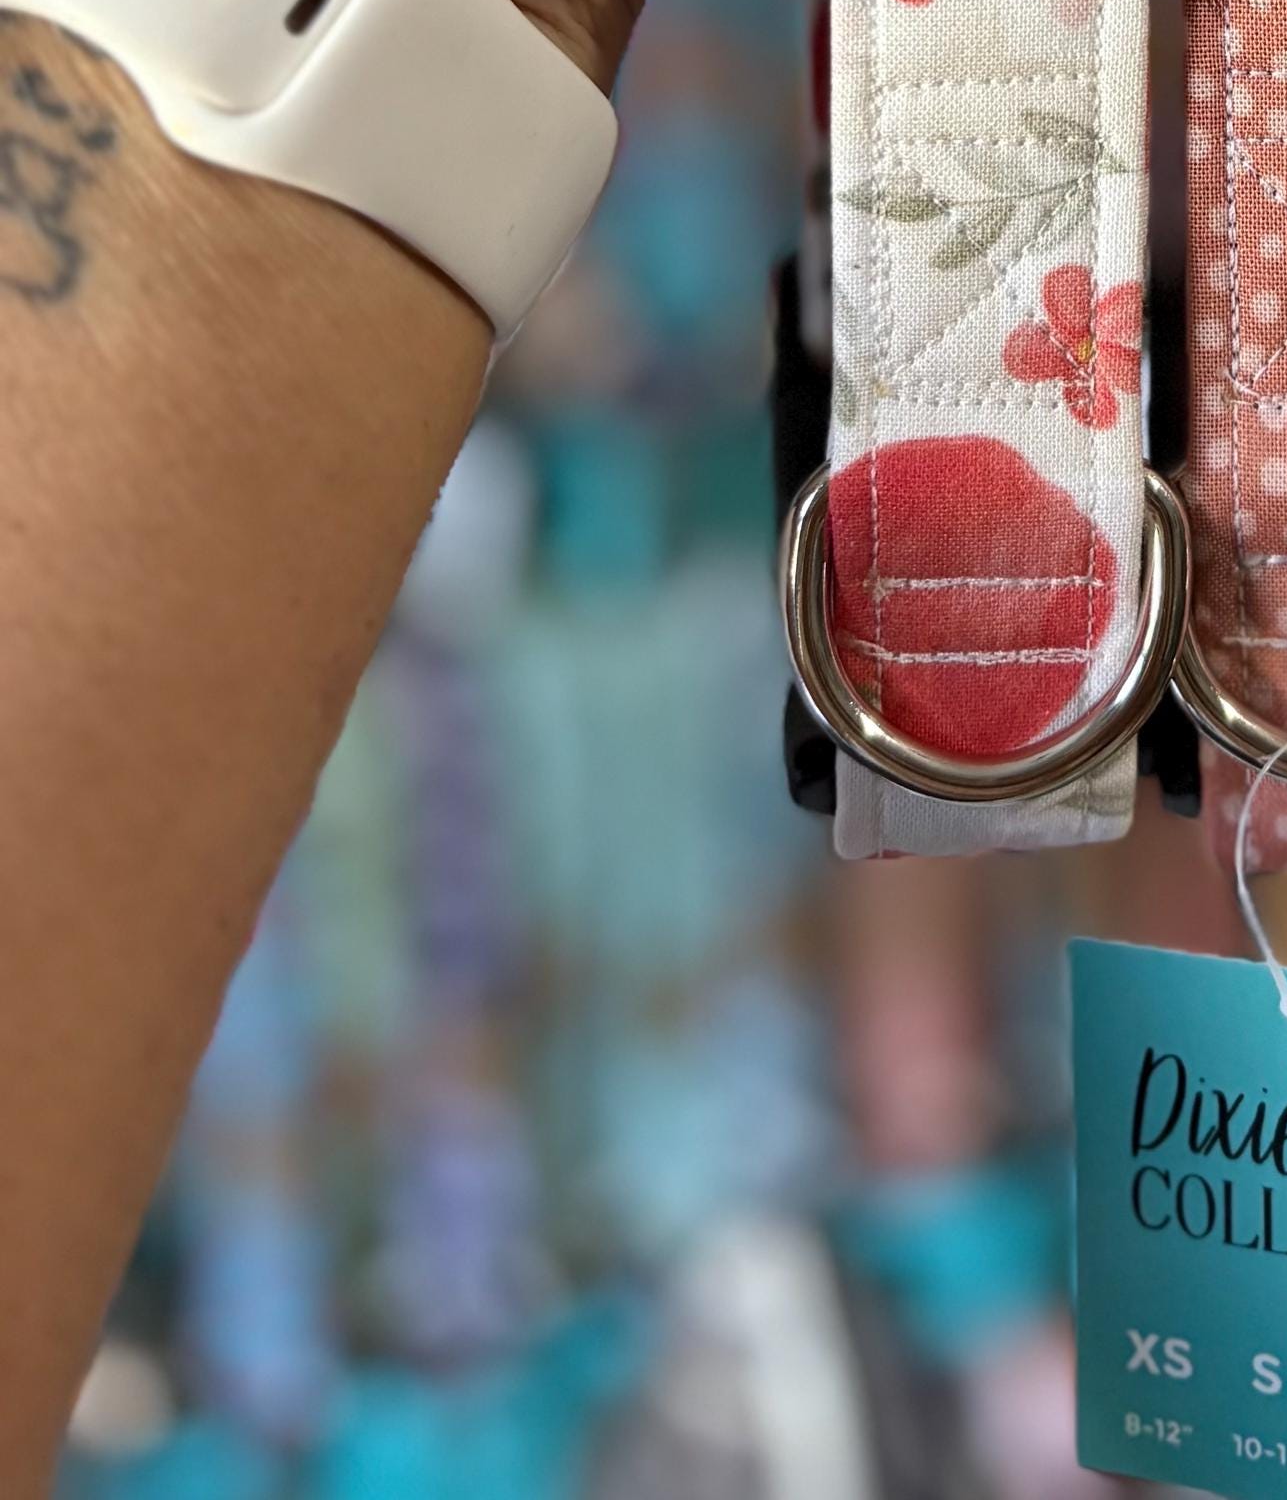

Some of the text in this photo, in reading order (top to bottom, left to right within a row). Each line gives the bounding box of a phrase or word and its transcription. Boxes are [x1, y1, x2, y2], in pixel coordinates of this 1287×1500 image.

[1125, 1328, 1194, 1379] XS
[1250, 1352, 1284, 1396] S
[1124, 1411, 1194, 1448] 8-12"
